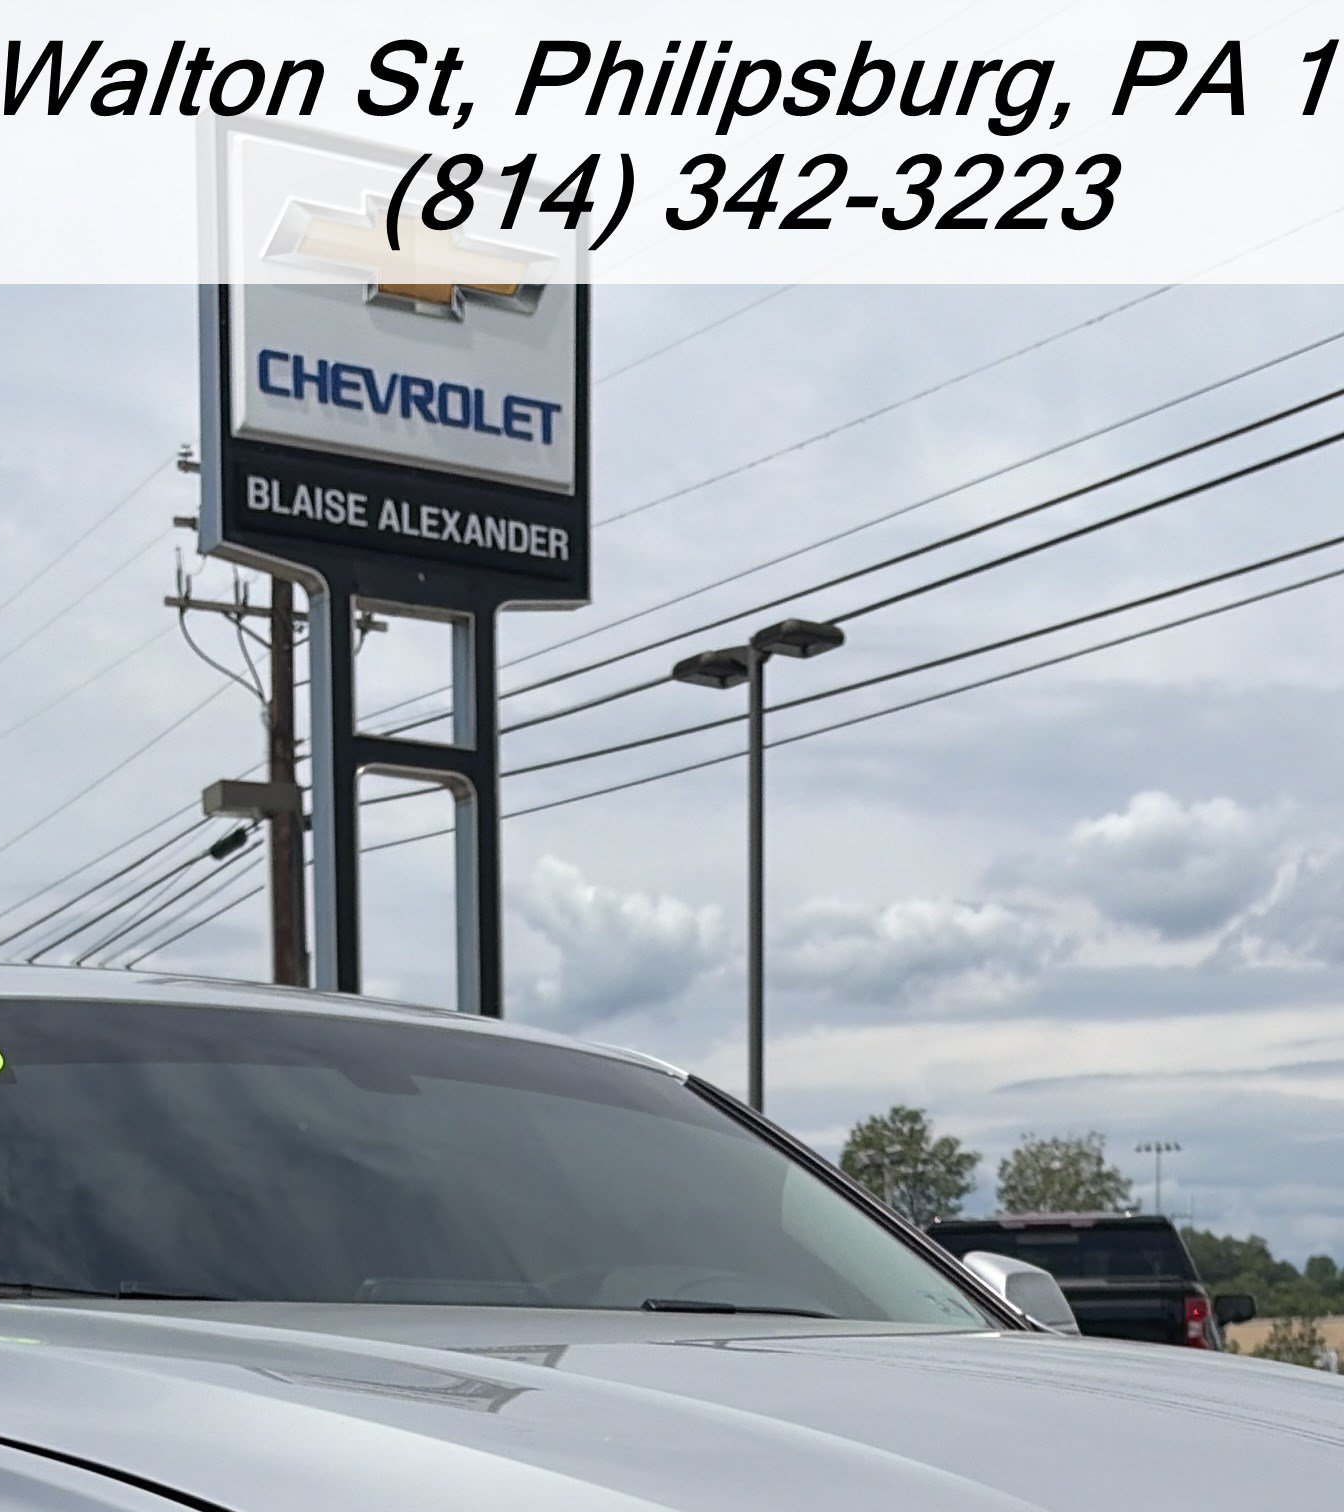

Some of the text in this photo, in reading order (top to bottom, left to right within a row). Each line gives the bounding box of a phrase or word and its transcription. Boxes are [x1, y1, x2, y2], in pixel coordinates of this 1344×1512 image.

[257, 348, 562, 446] CHEVROLET
[247, 474, 570, 562] BLAISE ALEXANDER
